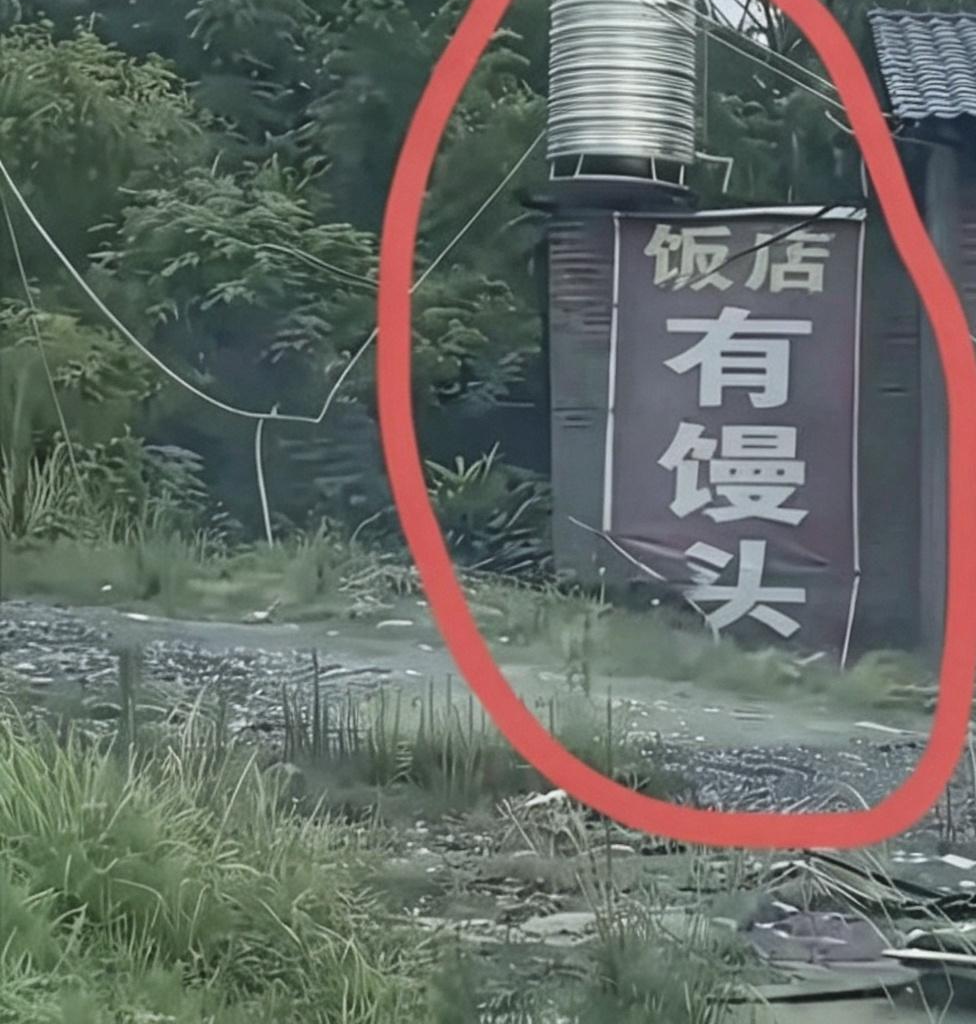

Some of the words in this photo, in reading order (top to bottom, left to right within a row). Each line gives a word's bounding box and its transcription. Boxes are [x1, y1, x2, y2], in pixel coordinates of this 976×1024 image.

[644, 224, 835, 293] 饭店
[658, 306, 813, 638] 有馒头
